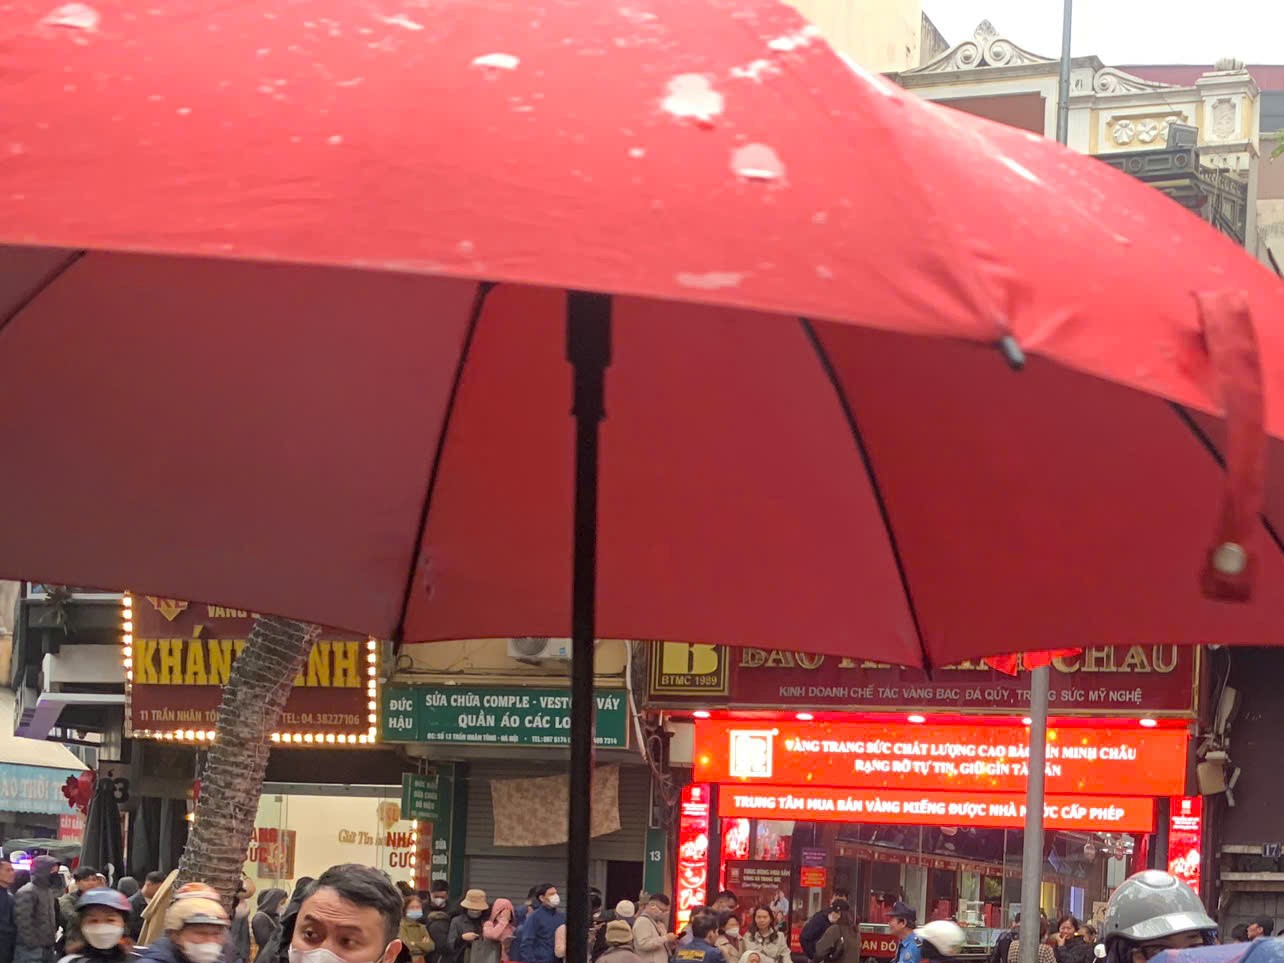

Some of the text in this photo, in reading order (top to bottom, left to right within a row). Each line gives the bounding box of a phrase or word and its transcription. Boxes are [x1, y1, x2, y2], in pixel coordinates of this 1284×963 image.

[135, 625, 247, 686] KHÁN
[661, 675, 692, 685] BTMC
[426, 693, 447, 707] SỬA
[450, 694, 480, 707] CHỮA
[483, 696, 529, 708] COMPLE
[596, 695, 620, 710] VÁY
[779, 686, 805, 697] KINH
[808, 687, 848, 698] DOANH
[850, 684, 874, 698] CHẾ
[965, 687, 982, 699] ĐÁ
[1016, 689, 1057, 701] TRG
[1060, 688, 1085, 701] SỨC
[1088, 687, 1107, 701] MỸ
[1109, 687, 1142, 704] NGHỆ
[389, 714, 413, 731] HẬU
[458, 709, 571, 728] QUẦN ÁO CÁC LO
[821, 740, 864, 753] TRANG
[978, 744, 1006, 757] CAO
[1061, 746, 1097, 760] MINH
[1099, 744, 1137, 761] CHÂU
[1011, 762, 1030, 776] TÀ
[989, 801, 1017, 816] NHÀ
[1089, 806, 1124, 821] PHÉP
[650, 851, 661, 861] 13
[1265, 844, 1278, 857] 17
[880, 940, 897, 951] ĐÓ
